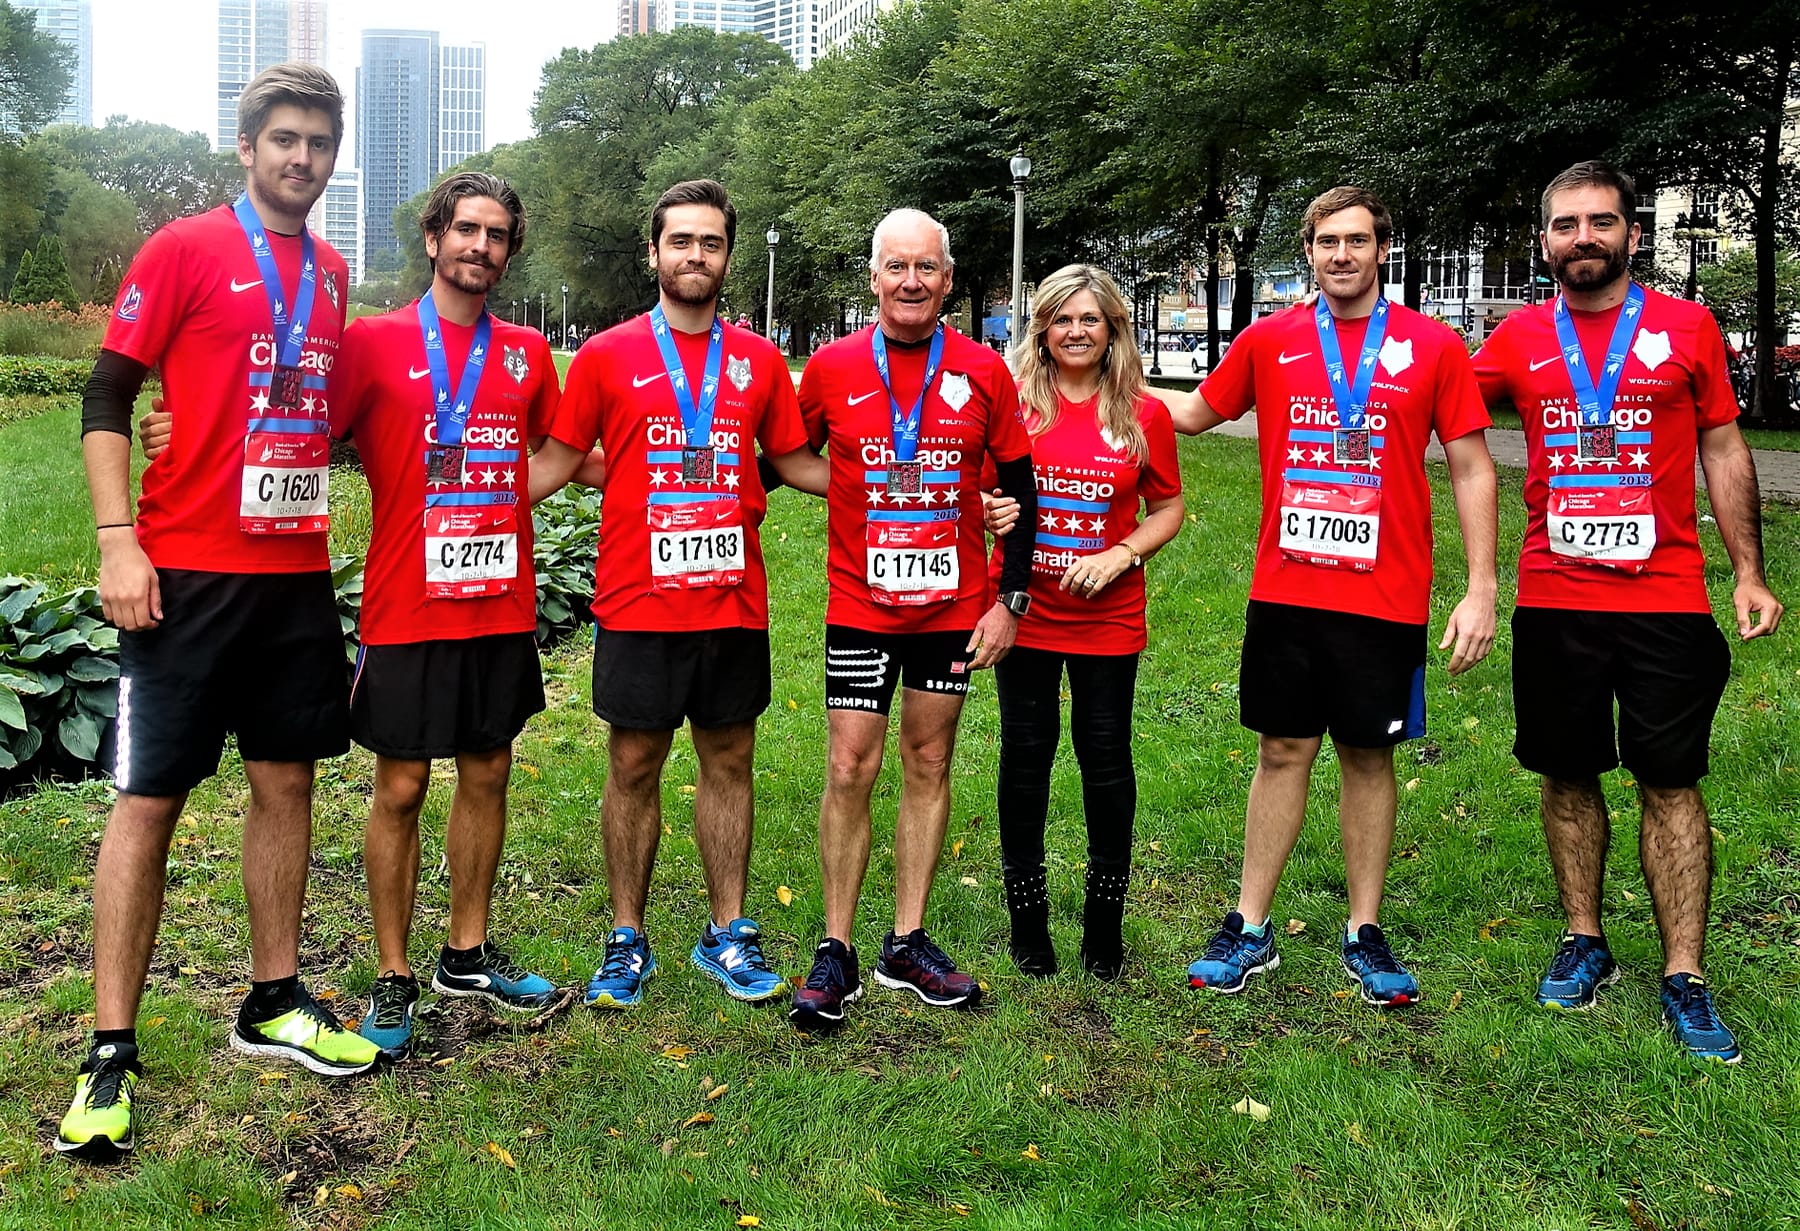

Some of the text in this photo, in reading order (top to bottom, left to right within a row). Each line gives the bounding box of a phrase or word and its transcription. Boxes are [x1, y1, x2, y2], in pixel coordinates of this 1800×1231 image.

[1289, 395, 1317, 403] BANK
[1540, 394, 1653, 407] BANK ERICA
[713, 417, 741, 427] ERICA
[424, 421, 520, 450] Cicago
[859, 437, 889, 445] BANK
[1065, 468, 1116, 479] AMERICA
[1033, 471, 1115, 502] hicago
[1351, 474, 1380, 487] 2018
[1618, 475, 1650, 487] 2018
[258, 473, 320, 502] C 1620
[933, 509, 958, 521] 2018
[1287, 512, 1371, 544] C 17003
[1562, 521, 1640, 547] C 2773
[658, 533, 738, 562] C 17183
[1077, 538, 1105, 549] 2018
[440, 539, 505, 568] C 2774
[1032, 548, 1081, 568] arath
[873, 552, 951, 578] C 17145
[1031, 565, 1065, 576] OLFPACK
[828, 696, 878, 709] COMPRE
